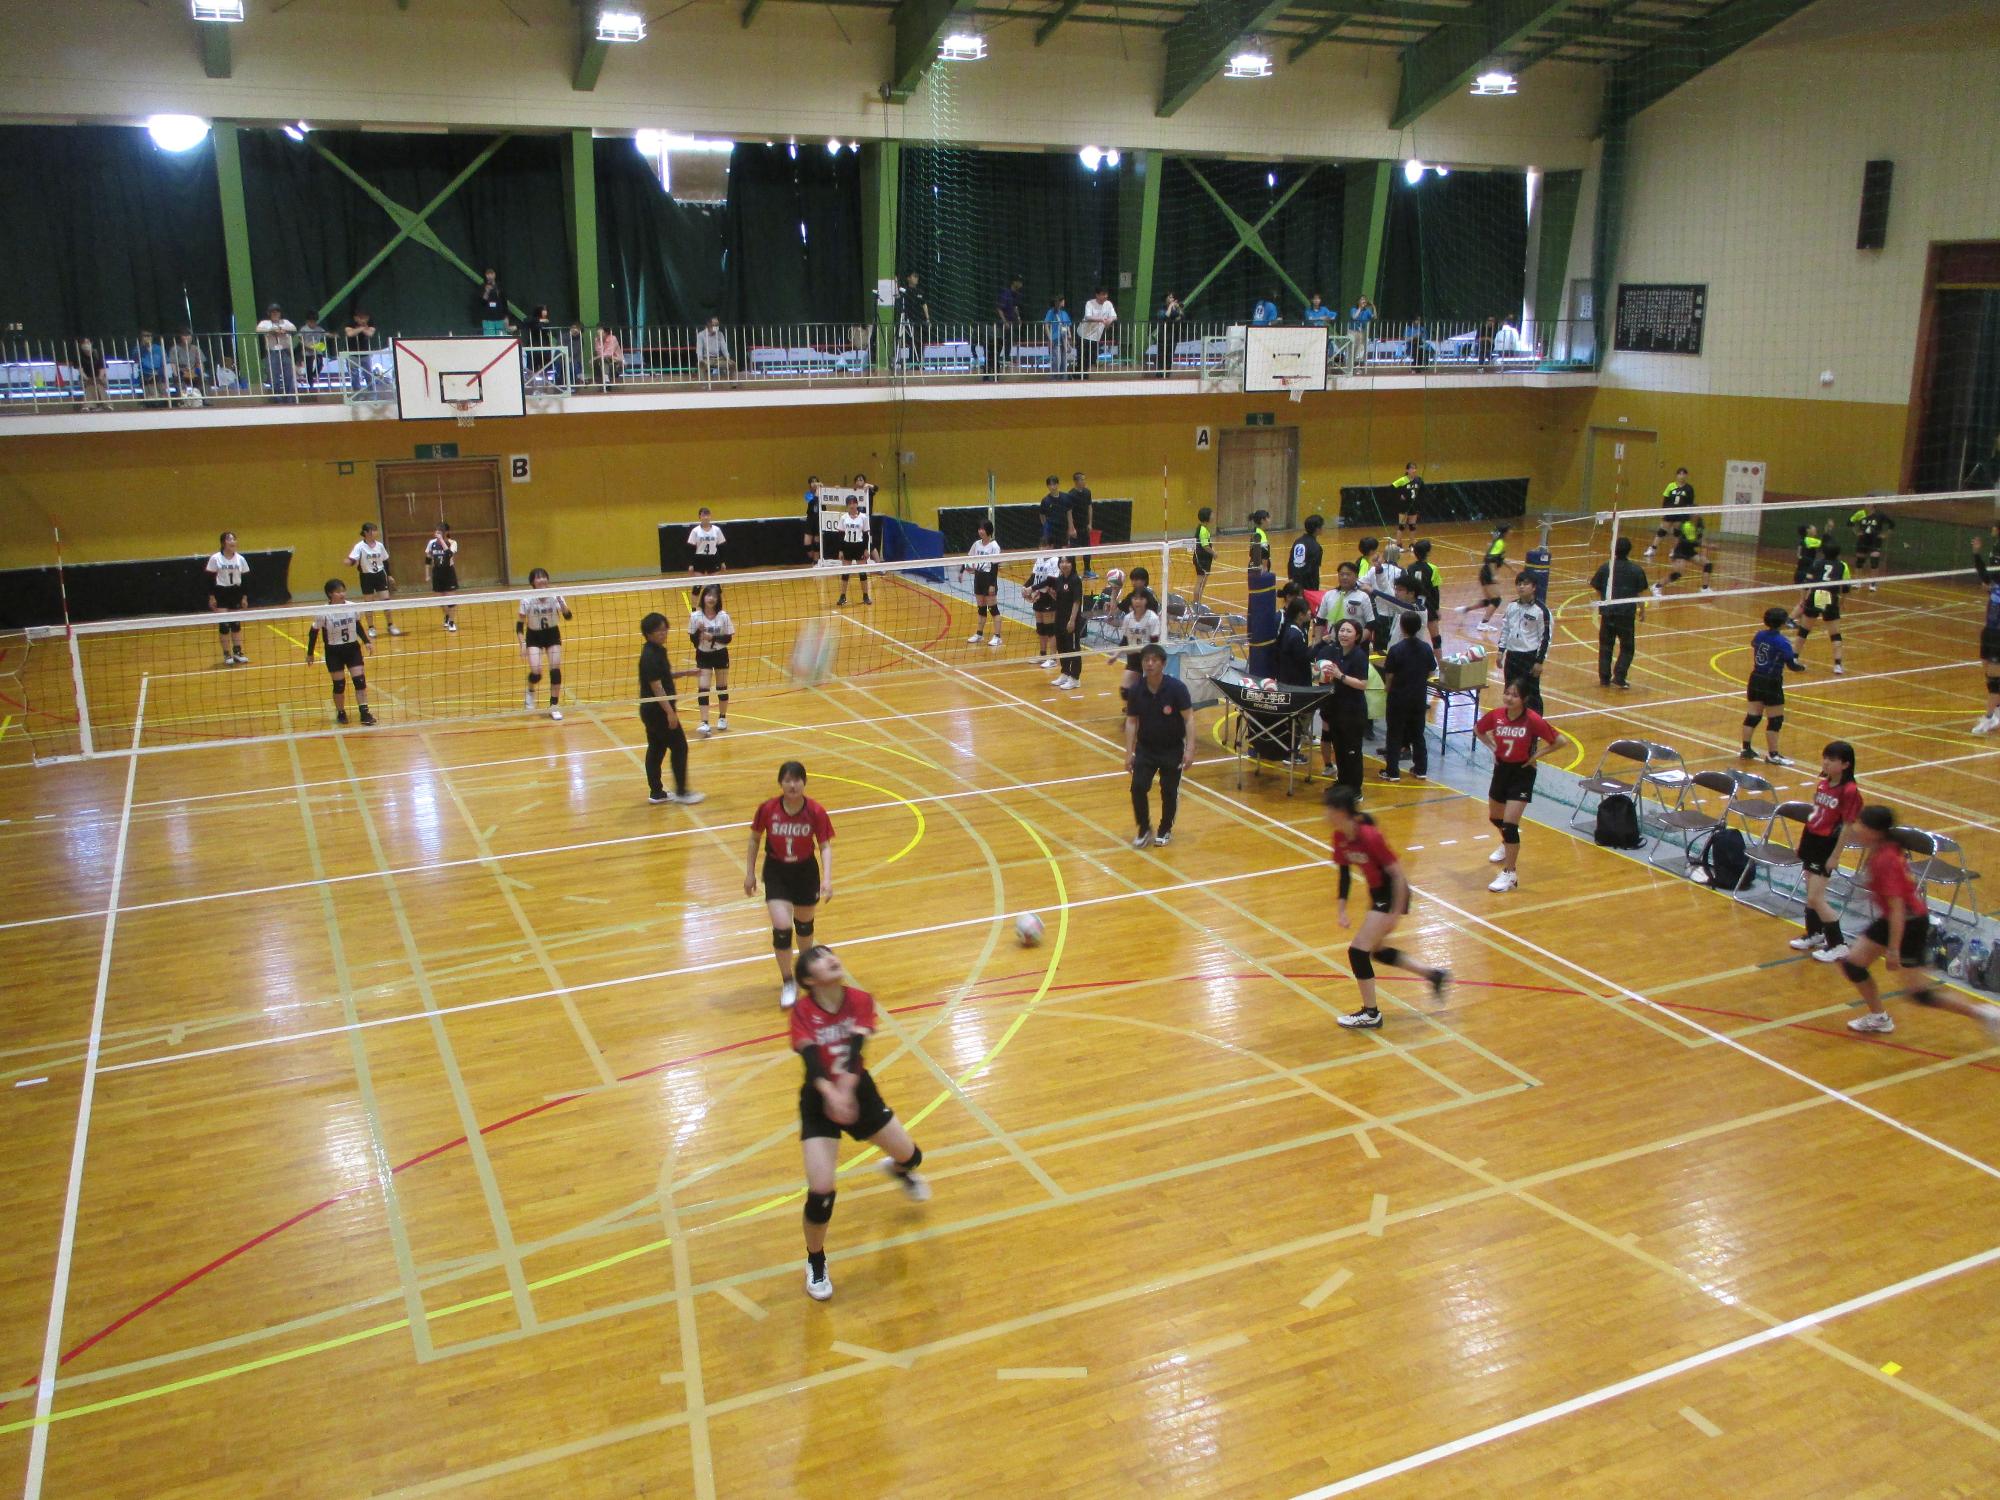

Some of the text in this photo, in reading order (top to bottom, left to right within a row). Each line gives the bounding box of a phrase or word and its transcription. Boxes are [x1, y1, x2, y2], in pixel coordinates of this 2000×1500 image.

[1197, 429, 1208, 446] A
[512, 458, 528, 477] B
[848, 530, 857, 542] 11
[704, 543, 710, 554] 4
[228, 572, 234, 585] 1
[541, 617, 549, 630] 6
[341, 628, 350, 642] 5
[1756, 641, 1770, 666] 5
[1496, 726, 1527, 738] SAIGO
[1503, 739, 1515, 757] 7
[771, 822, 811, 837] SAIGO
[785, 837, 794, 857] 1
